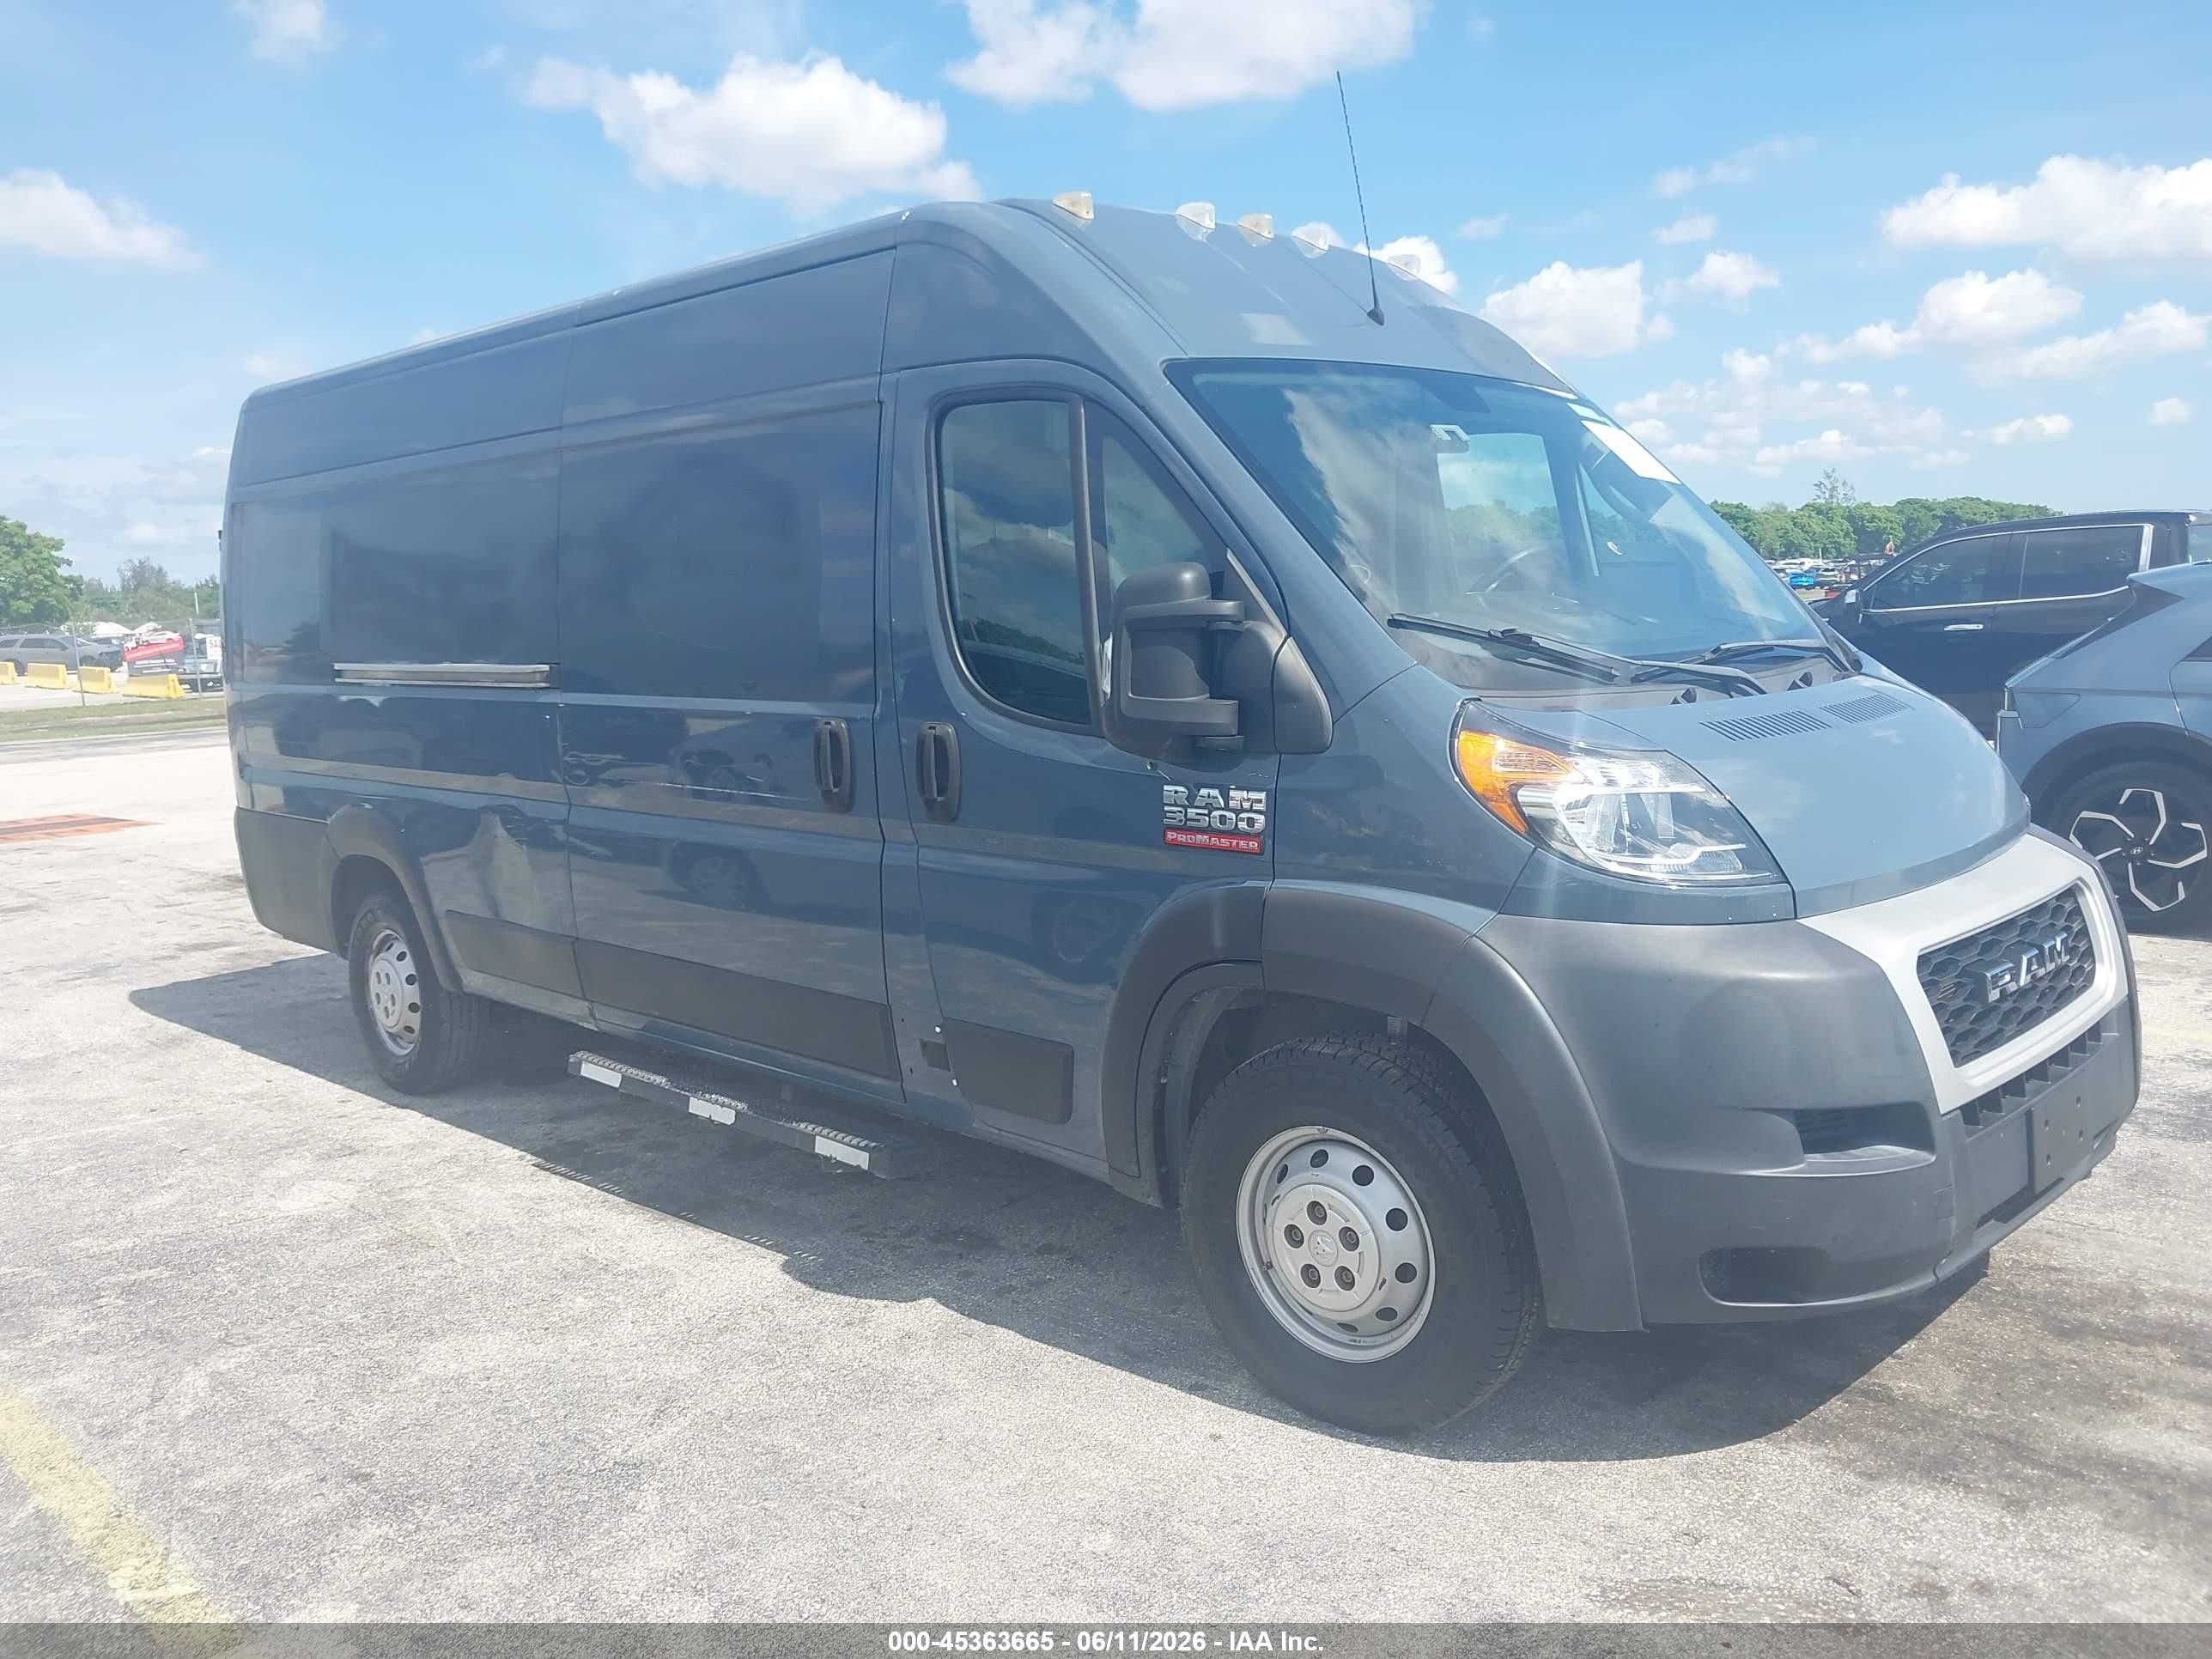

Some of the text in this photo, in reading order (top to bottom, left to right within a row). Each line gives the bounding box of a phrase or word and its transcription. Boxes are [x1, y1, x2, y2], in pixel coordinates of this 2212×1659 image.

[1163, 785, 1267, 811] RAM
[1163, 805, 1266, 834] 3500
[1983, 931, 2070, 1003] RAM
